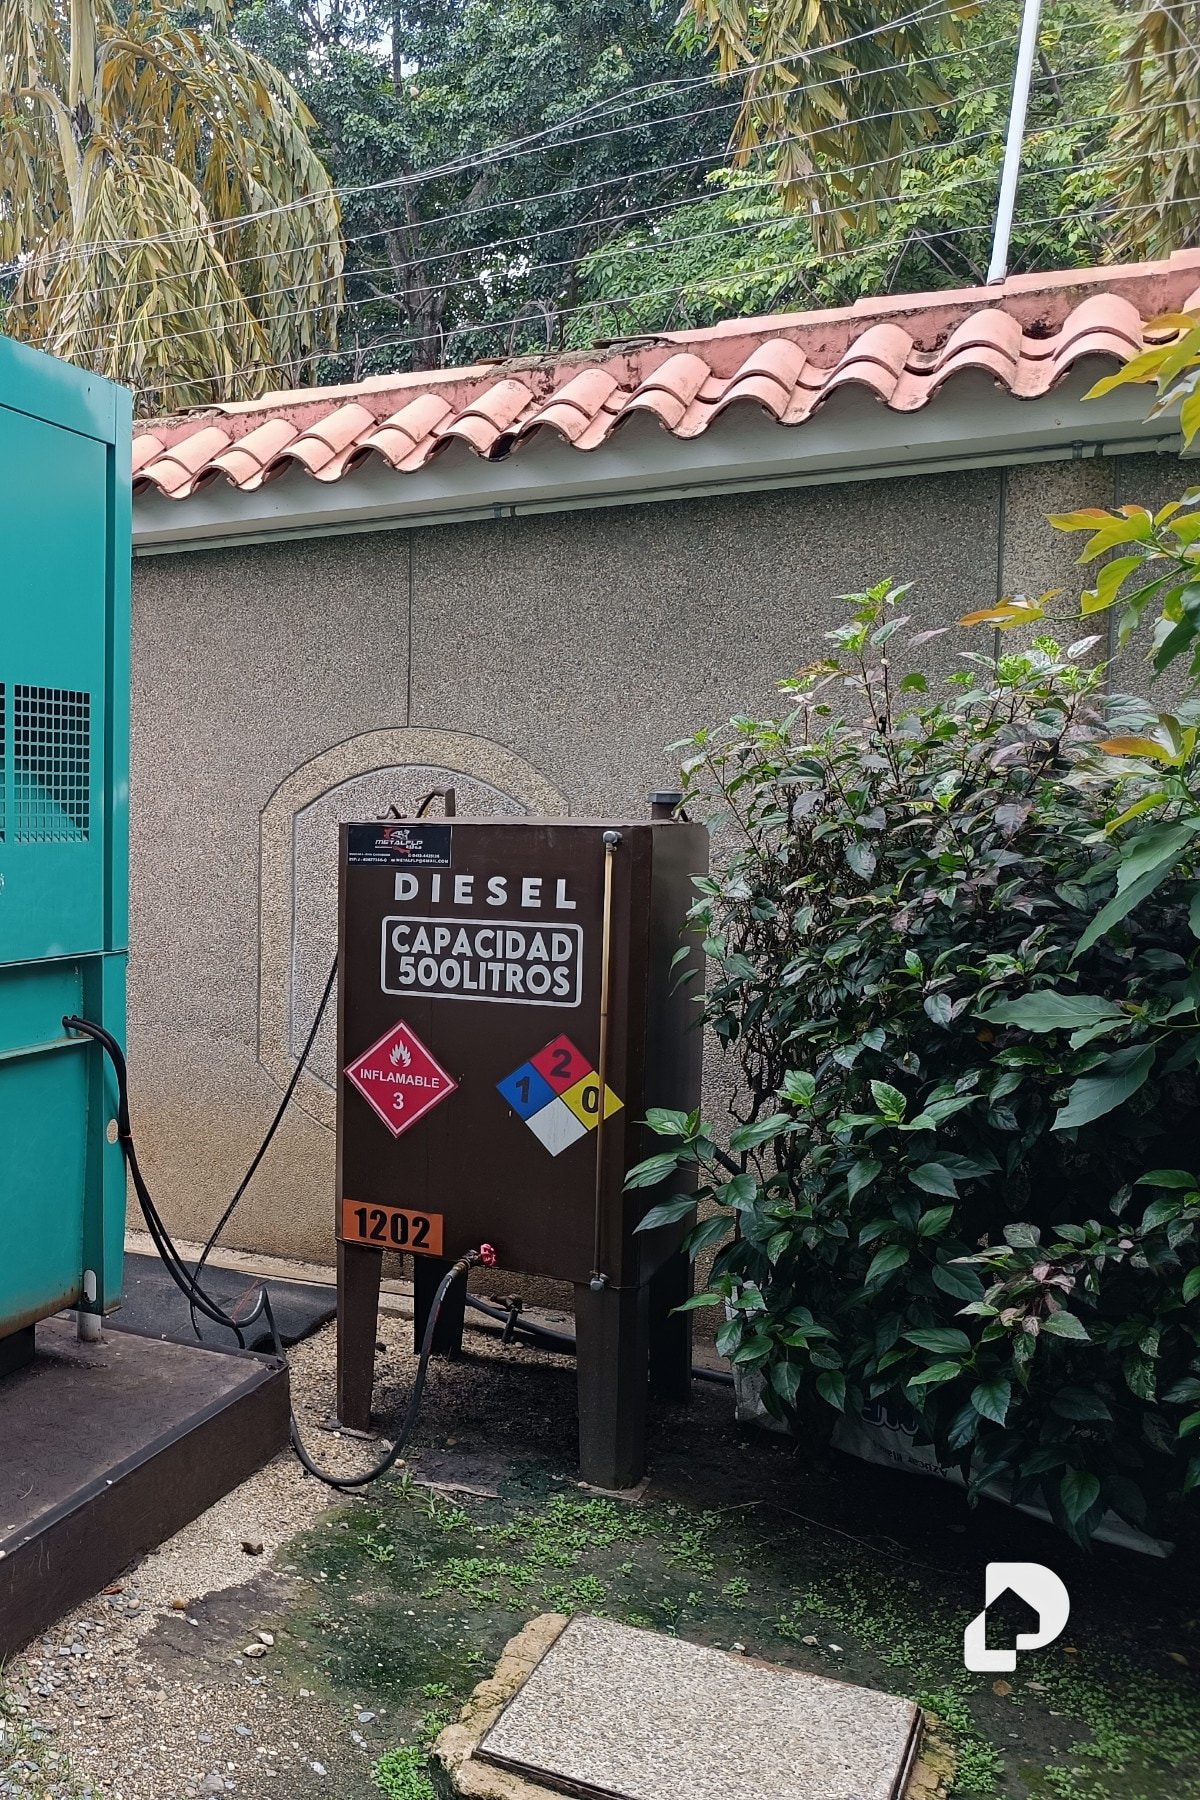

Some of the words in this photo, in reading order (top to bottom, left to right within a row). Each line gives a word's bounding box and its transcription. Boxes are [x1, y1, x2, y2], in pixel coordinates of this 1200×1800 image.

[395, 872, 577, 910] DIESEL
[391, 925, 573, 962] CAPACIDAD
[398, 956, 570, 996] 500LITROS
[360, 1068, 440, 1090] INFLAMABLE
[551, 1048, 573, 1079] 2
[392, 1091, 404, 1111] 3
[515, 1076, 530, 1104] 1
[581, 1085, 600, 1114] 0
[354, 1207, 431, 1249] 1202
